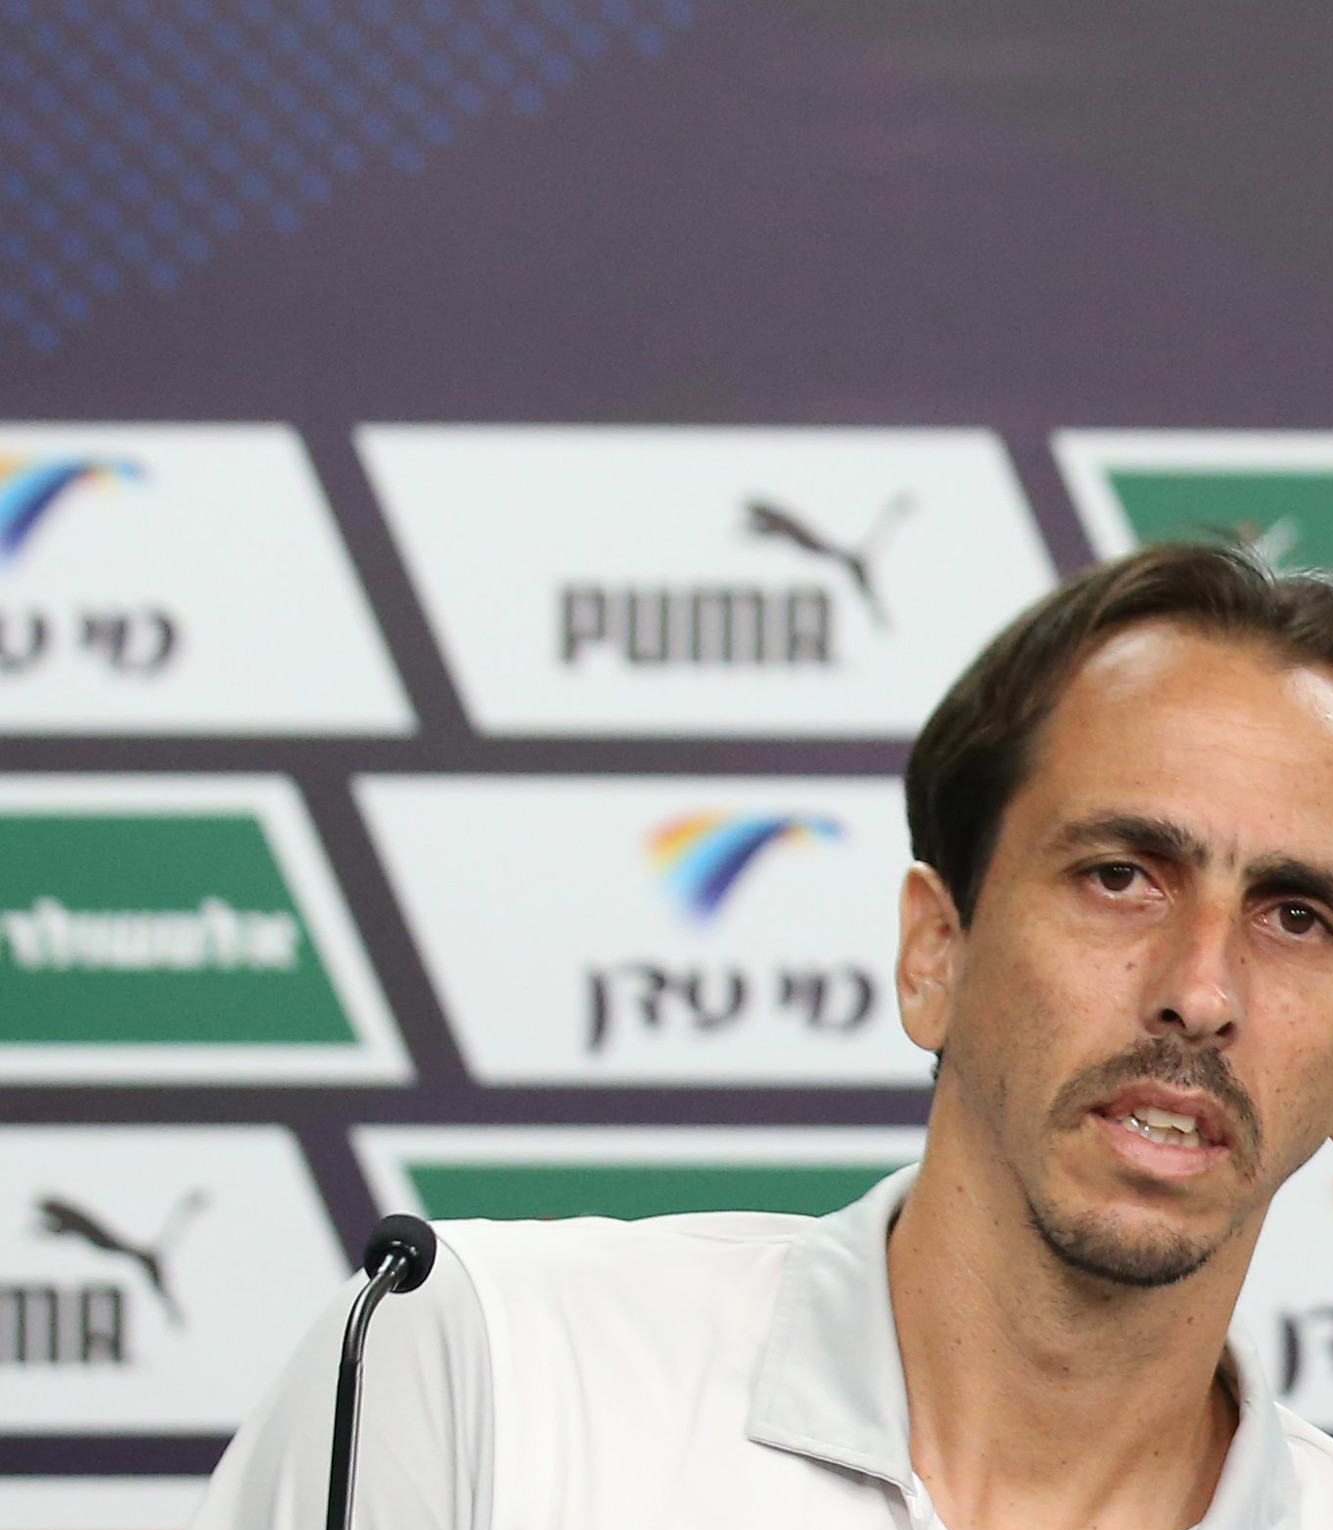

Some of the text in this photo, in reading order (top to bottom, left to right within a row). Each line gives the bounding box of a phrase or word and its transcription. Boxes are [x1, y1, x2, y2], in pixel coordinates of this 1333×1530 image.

[559, 586, 831, 665] PUMA
[585, 962, 875, 1054] מי עדן
